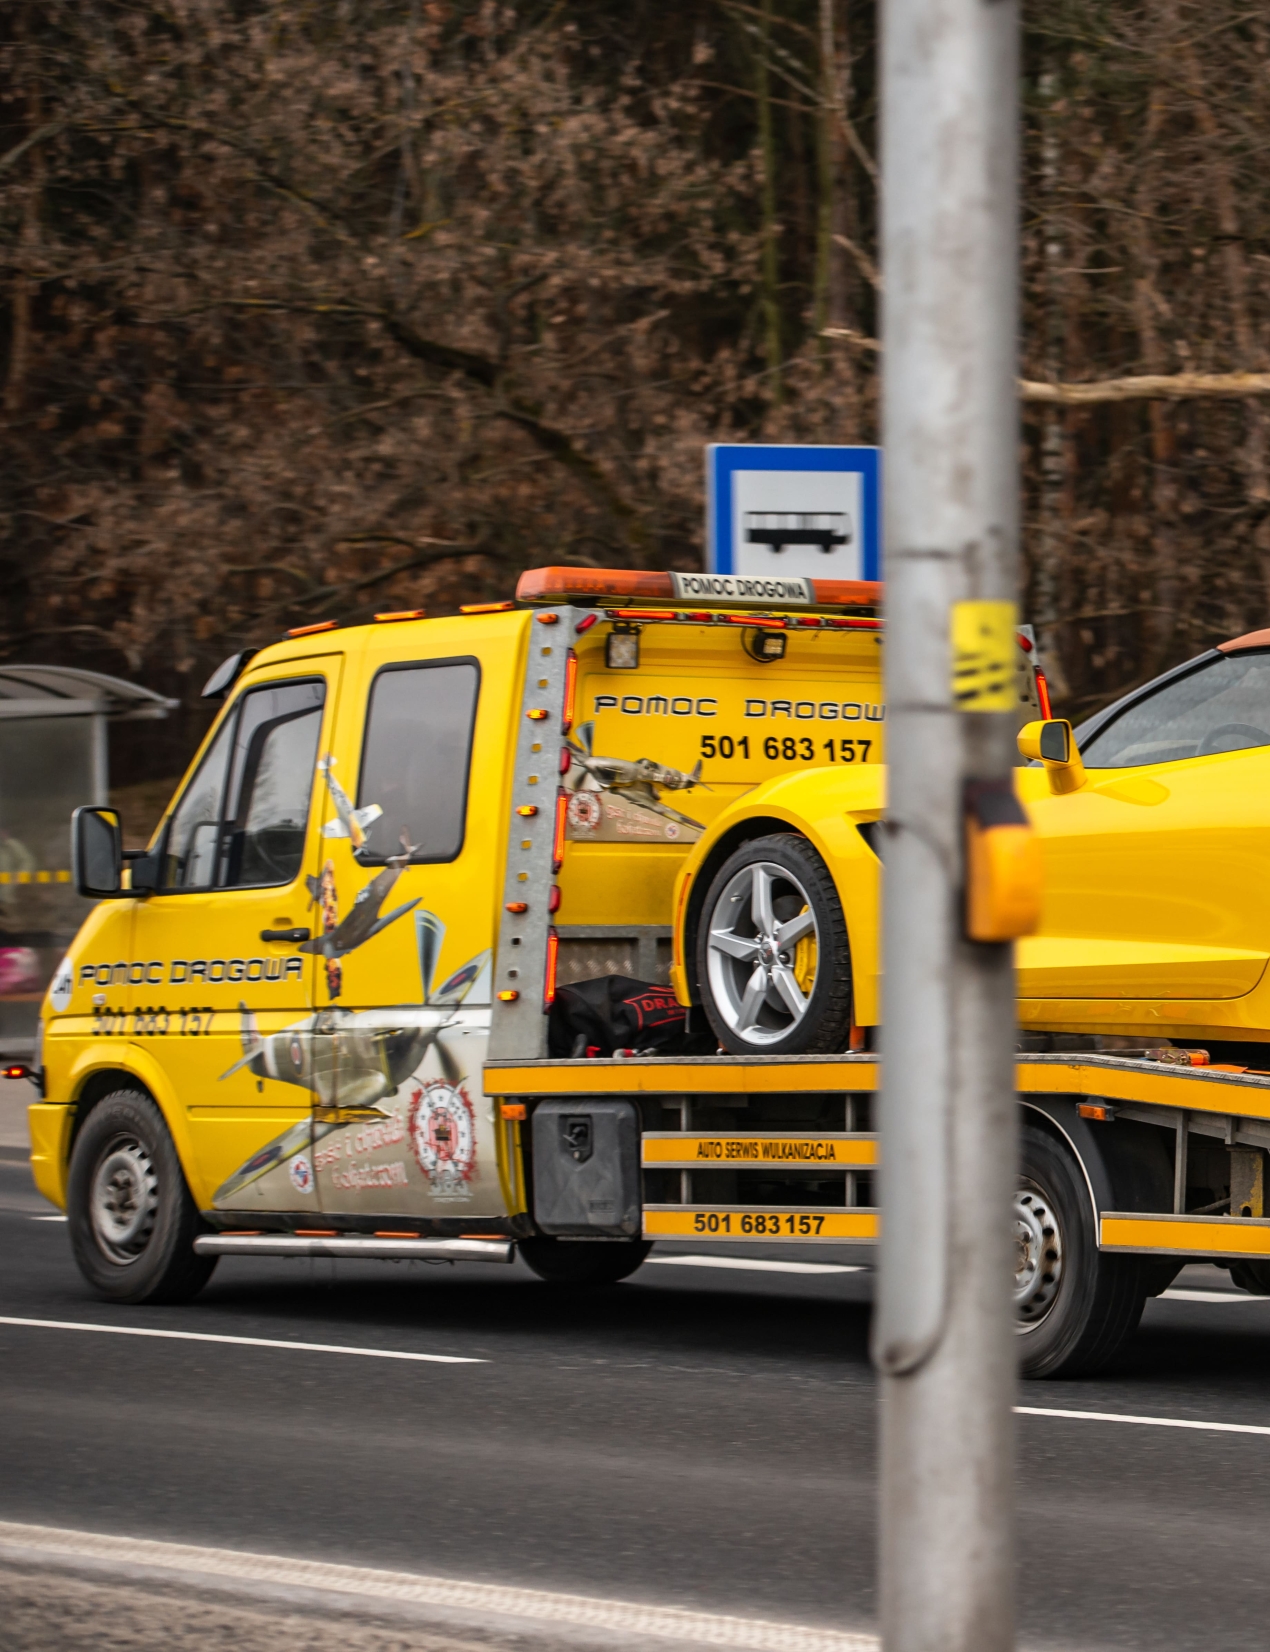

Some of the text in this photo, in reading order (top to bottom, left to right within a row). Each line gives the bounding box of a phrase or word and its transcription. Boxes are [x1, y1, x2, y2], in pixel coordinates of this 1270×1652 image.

[682, 577, 806, 600] POMOC DROGOWA
[594, 694, 718, 717] POMOC
[700, 735, 872, 762] 501 683 157
[78, 961, 163, 988] POMOC
[168, 956, 304, 985] DROGOWA
[92, 1006, 215, 1036] 501 683 157
[697, 1142, 836, 1161] AUTO SERWIS WULKANIZACJA
[694, 1213, 826, 1235] 501 683 157
